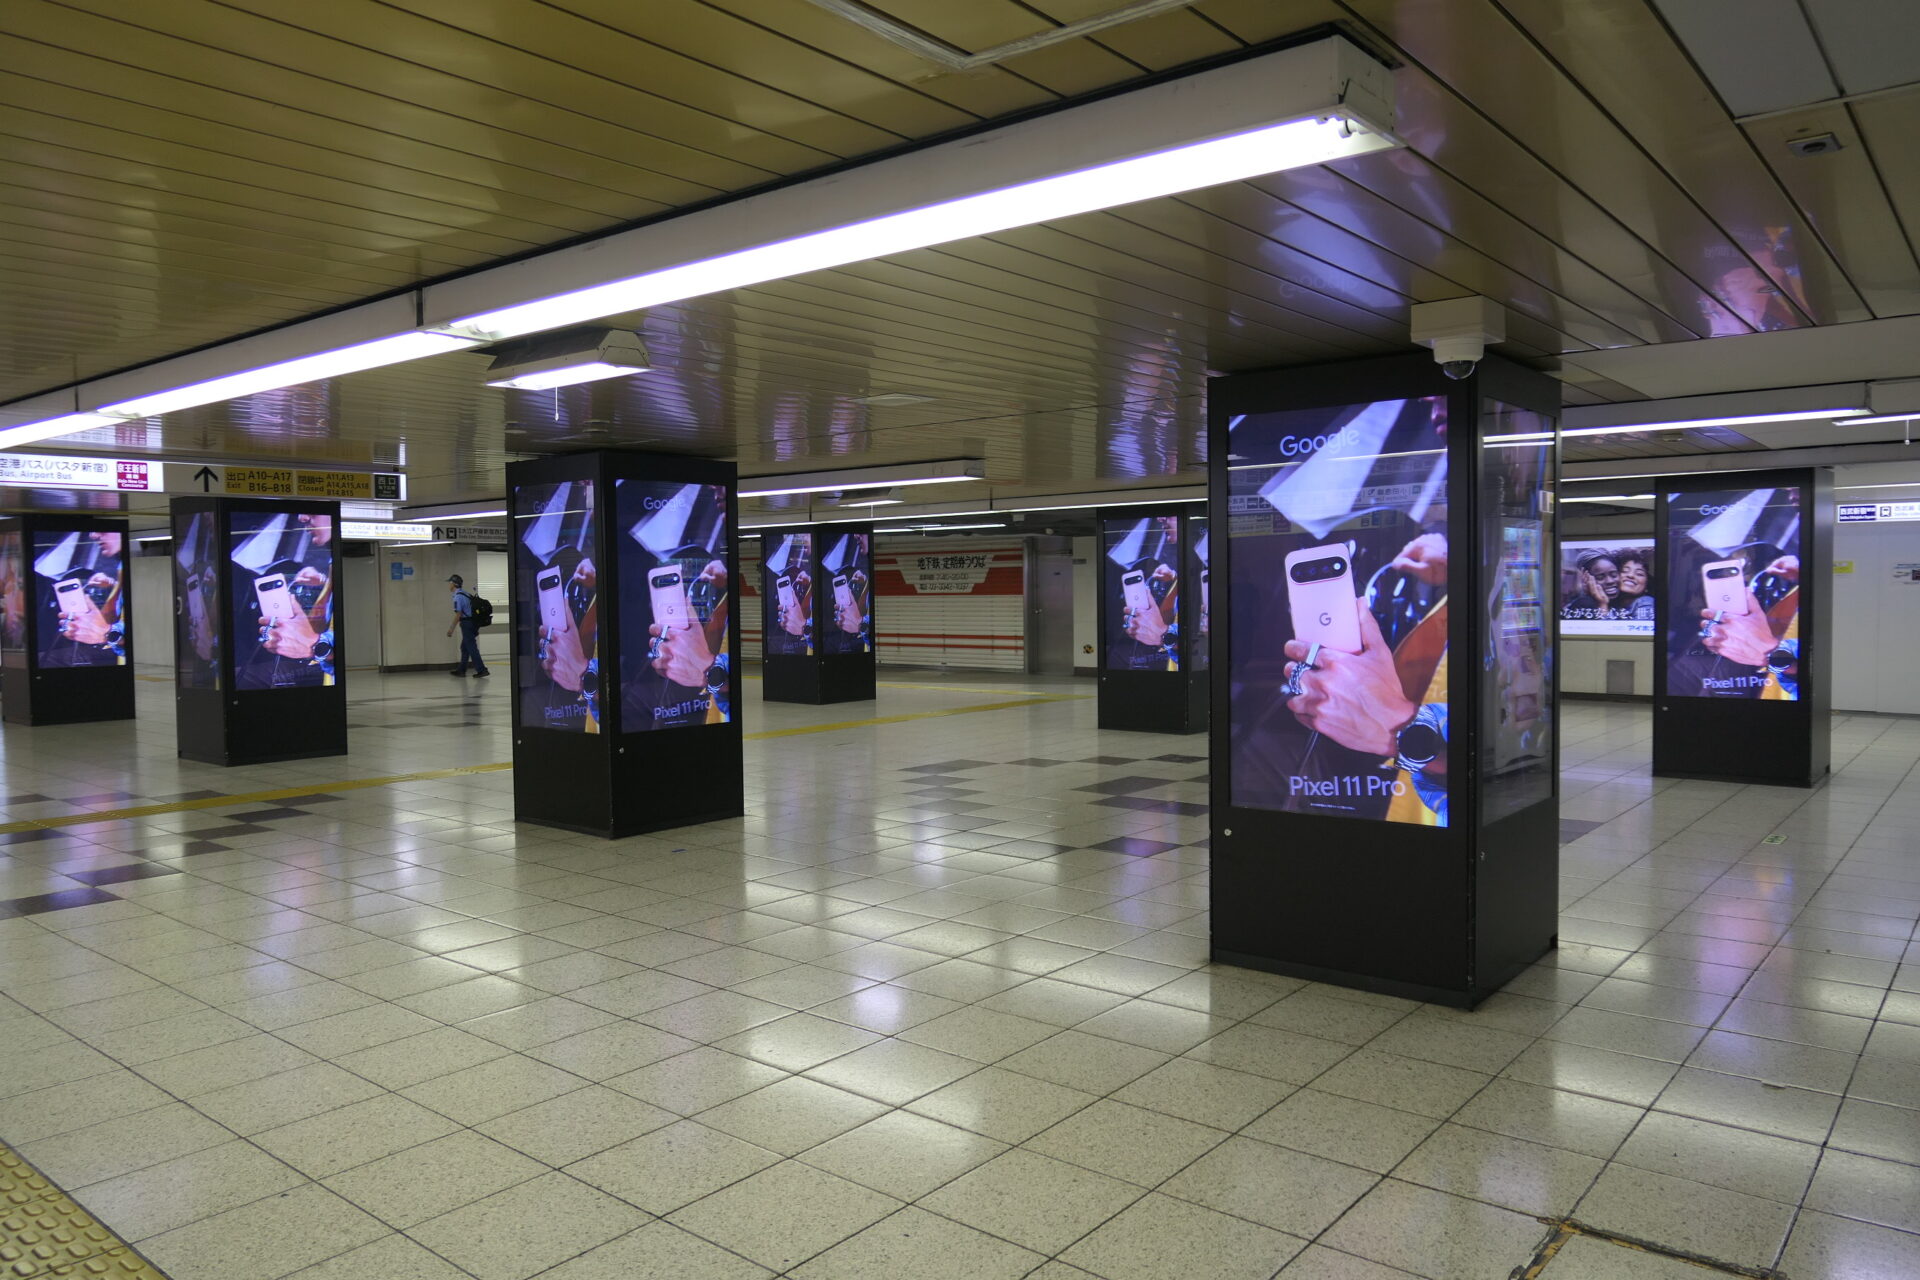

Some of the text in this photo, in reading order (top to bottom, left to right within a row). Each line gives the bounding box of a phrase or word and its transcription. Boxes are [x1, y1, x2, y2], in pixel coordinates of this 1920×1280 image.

[1279, 426, 1360, 456] Google
[21, 470, 54, 480] Airport
[56, 472, 73, 480] Bus
[227, 472, 245, 481] 出口
[1319, 612, 1332, 626] G
[1702, 676, 1773, 689] Pixel 11 Pro
[544, 703, 589, 719] Pixel 11 Pro
[654, 699, 712, 719] Pixel 11 Pro
[1289, 775, 1407, 797] Pixel 11 Pro
